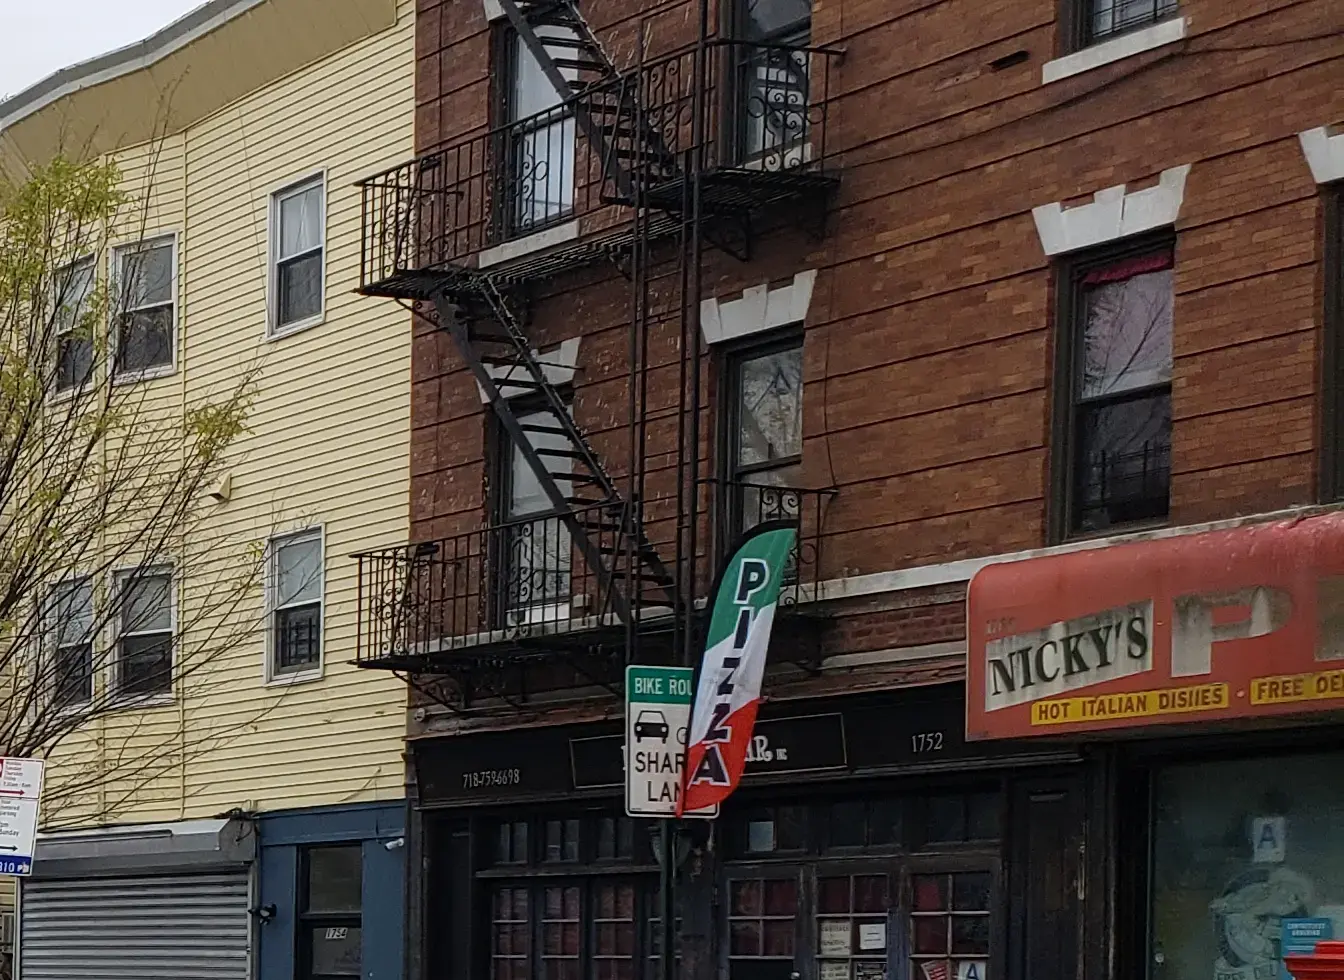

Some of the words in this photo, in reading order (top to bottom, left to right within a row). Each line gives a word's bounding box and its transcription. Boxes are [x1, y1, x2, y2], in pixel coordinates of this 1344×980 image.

[988, 616, 1148, 696] NICKY'S
[687, 557, 770, 790] PIZZA
[634, 677, 664, 695] BIKE
[1038, 703, 1070, 721] HOT
[1081, 695, 1148, 717] ITALIAN
[1159, 687, 1223, 710] DISHES
[1257, 678, 1304, 700] FREE
[1316, 675, 1344, 694] DE
[912, 731, 944, 752] 1752
[462, 768, 521, 789] 718-759-6698
[0, 829, 20, 837] Sunday
[1258, 823, 1276, 849] A
